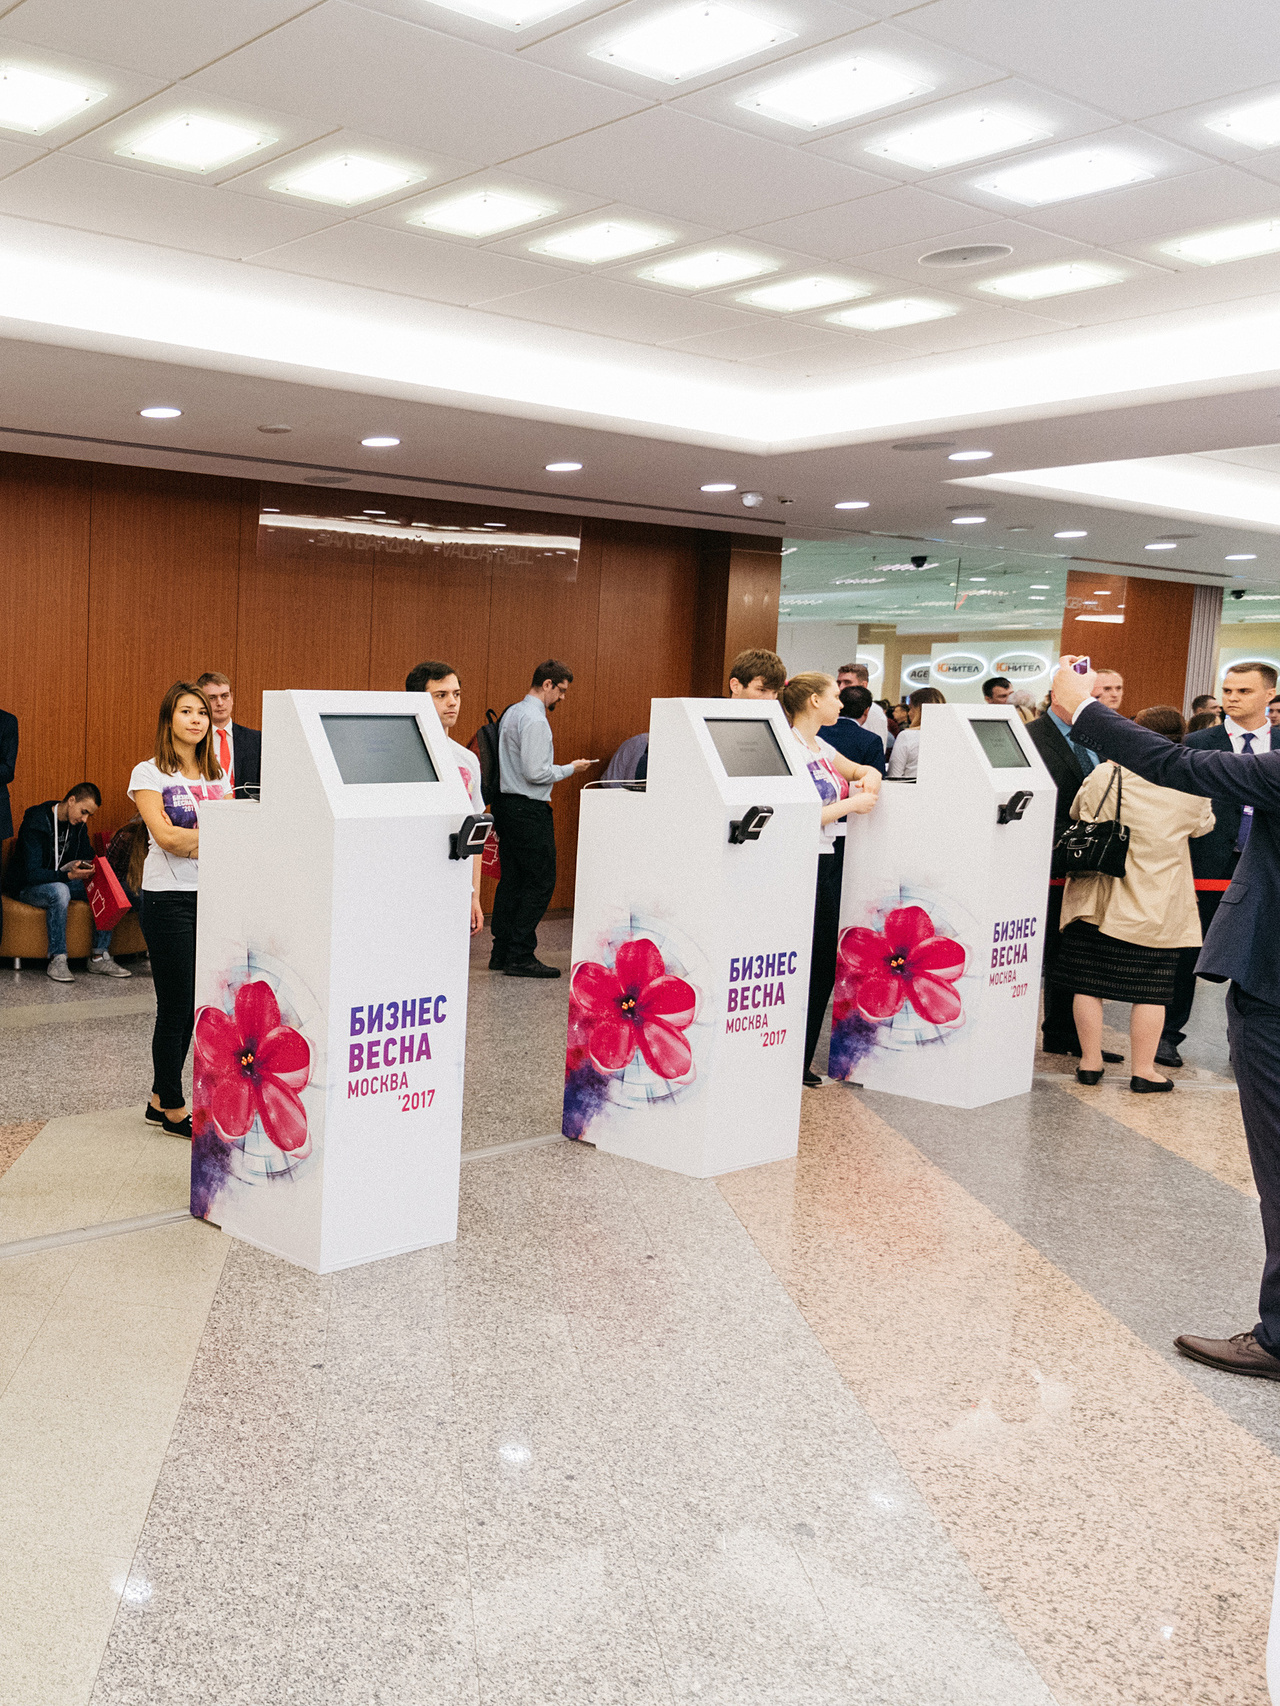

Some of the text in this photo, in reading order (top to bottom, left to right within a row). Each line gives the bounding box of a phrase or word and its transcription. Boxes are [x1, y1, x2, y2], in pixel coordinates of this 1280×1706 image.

[993, 916, 1037, 943] БИЗНЕС
[729, 950, 798, 983] БИЗНЕС
[990, 942, 1028, 969] ВЕСНА
[988, 969, 1017, 987] МОСКВА
[727, 981, 785, 1013] ВЕСНА
[350, 994, 447, 1037] БИЗНЕС
[725, 1013, 768, 1034] МОСКВА
[761, 1029, 787, 1047] '2017
[348, 1032, 432, 1073] ВЕСНА
[347, 1071, 408, 1099] МОСКВА
[397, 1088, 436, 1112] '2017
